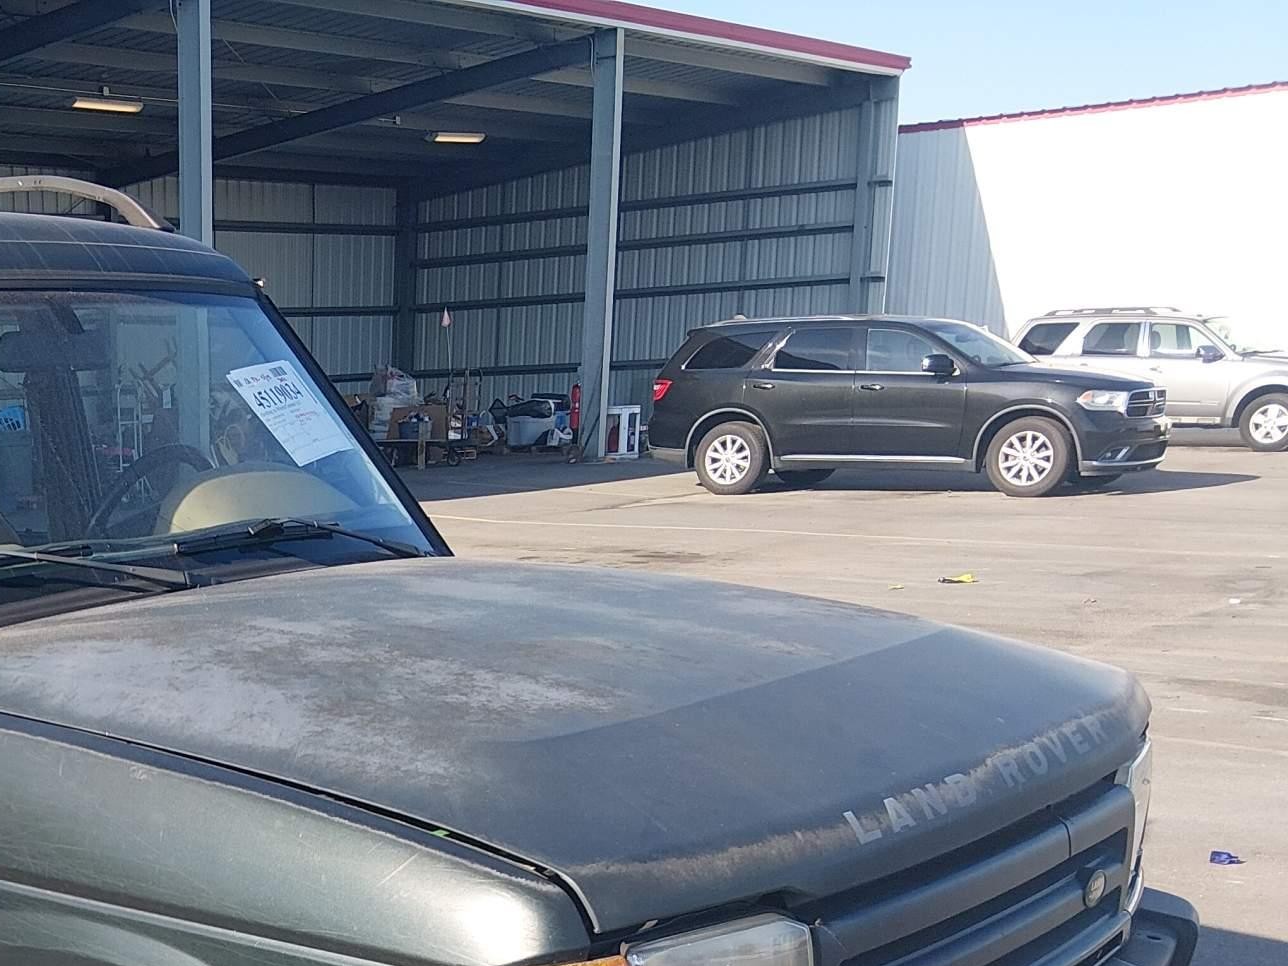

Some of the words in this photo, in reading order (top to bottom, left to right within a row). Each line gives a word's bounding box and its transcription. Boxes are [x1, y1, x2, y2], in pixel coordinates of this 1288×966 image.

[253, 383, 304, 409] 45119034
[842, 773, 976, 845] LAND
[991, 711, 1109, 787] ROVER
